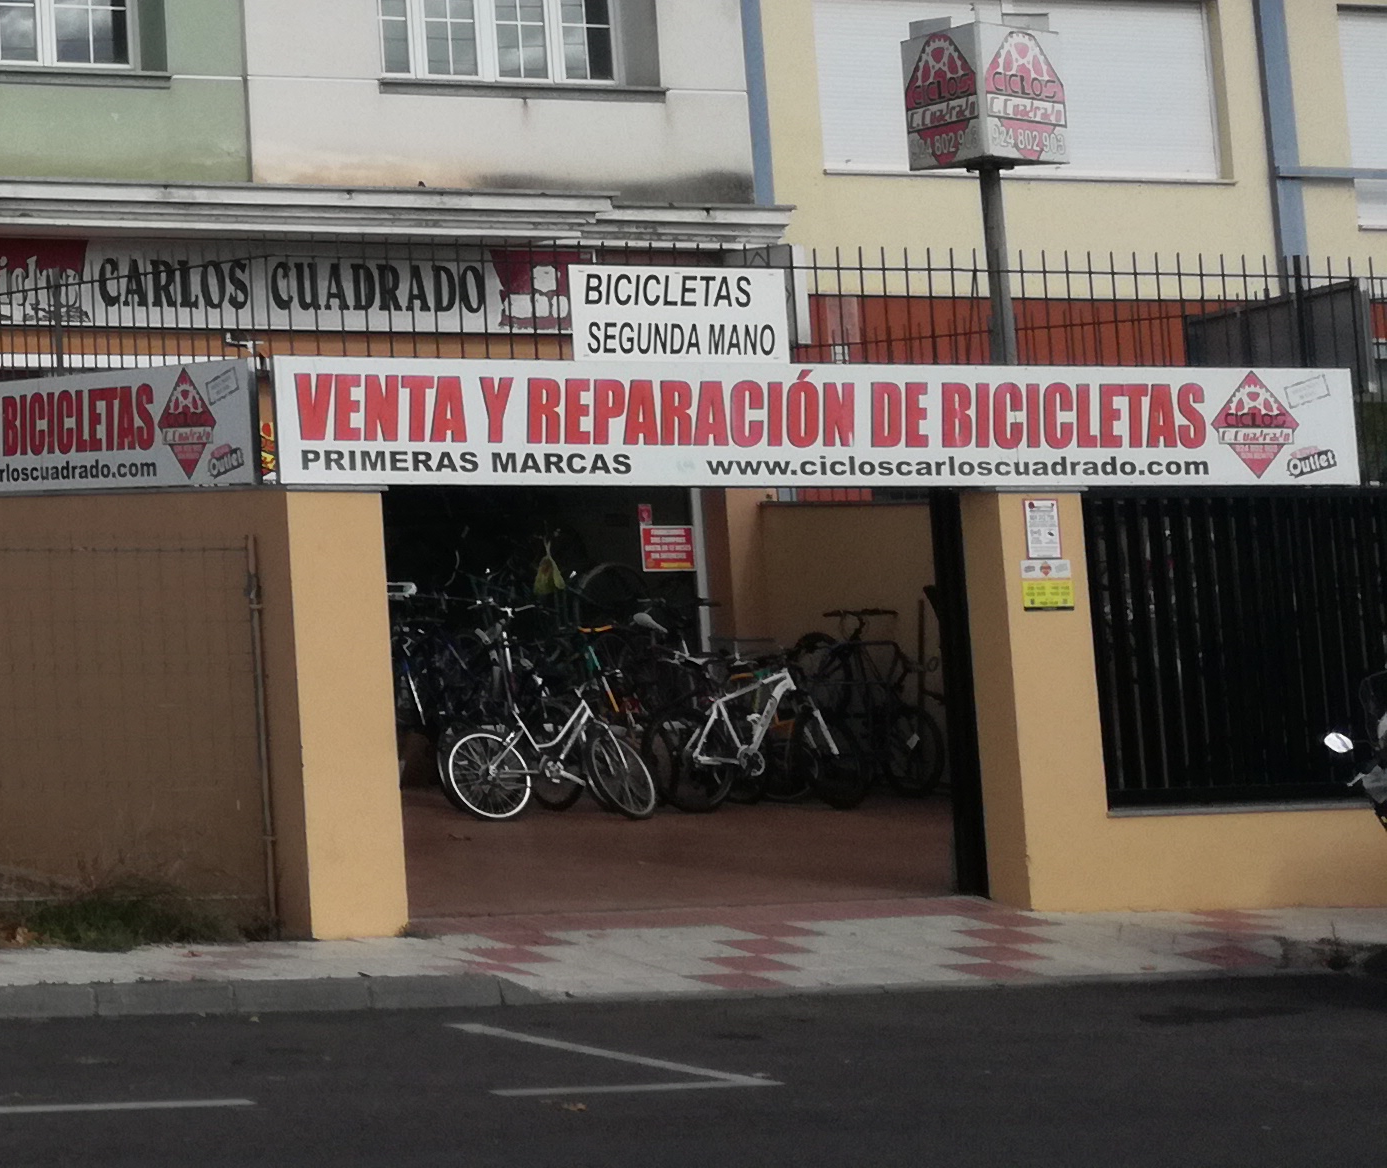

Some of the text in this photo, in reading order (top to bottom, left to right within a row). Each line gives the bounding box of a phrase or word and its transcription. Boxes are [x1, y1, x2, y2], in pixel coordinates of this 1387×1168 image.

[914, 73, 970, 106] CICLOS
[992, 71, 1058, 99] CICLOS
[935, 133, 956, 155] 802
[991, 123, 1066, 155] 924 802 903
[99, 258, 251, 310] CARLOS
[270, 261, 485, 314] CUADRADO
[585, 273, 752, 308] BICICLETAS
[588, 321, 776, 356] SEGUNDA MANO
[2, 383, 155, 457] BICICLETAS
[293, 369, 1206, 449] VENTA Y REPARACIÓN DE BICICLETAS
[301, 450, 1210, 477] PRIMERAS MARCAS www.cicloscarloscuadrado.com
[1288, 450, 1337, 475] Outlet
